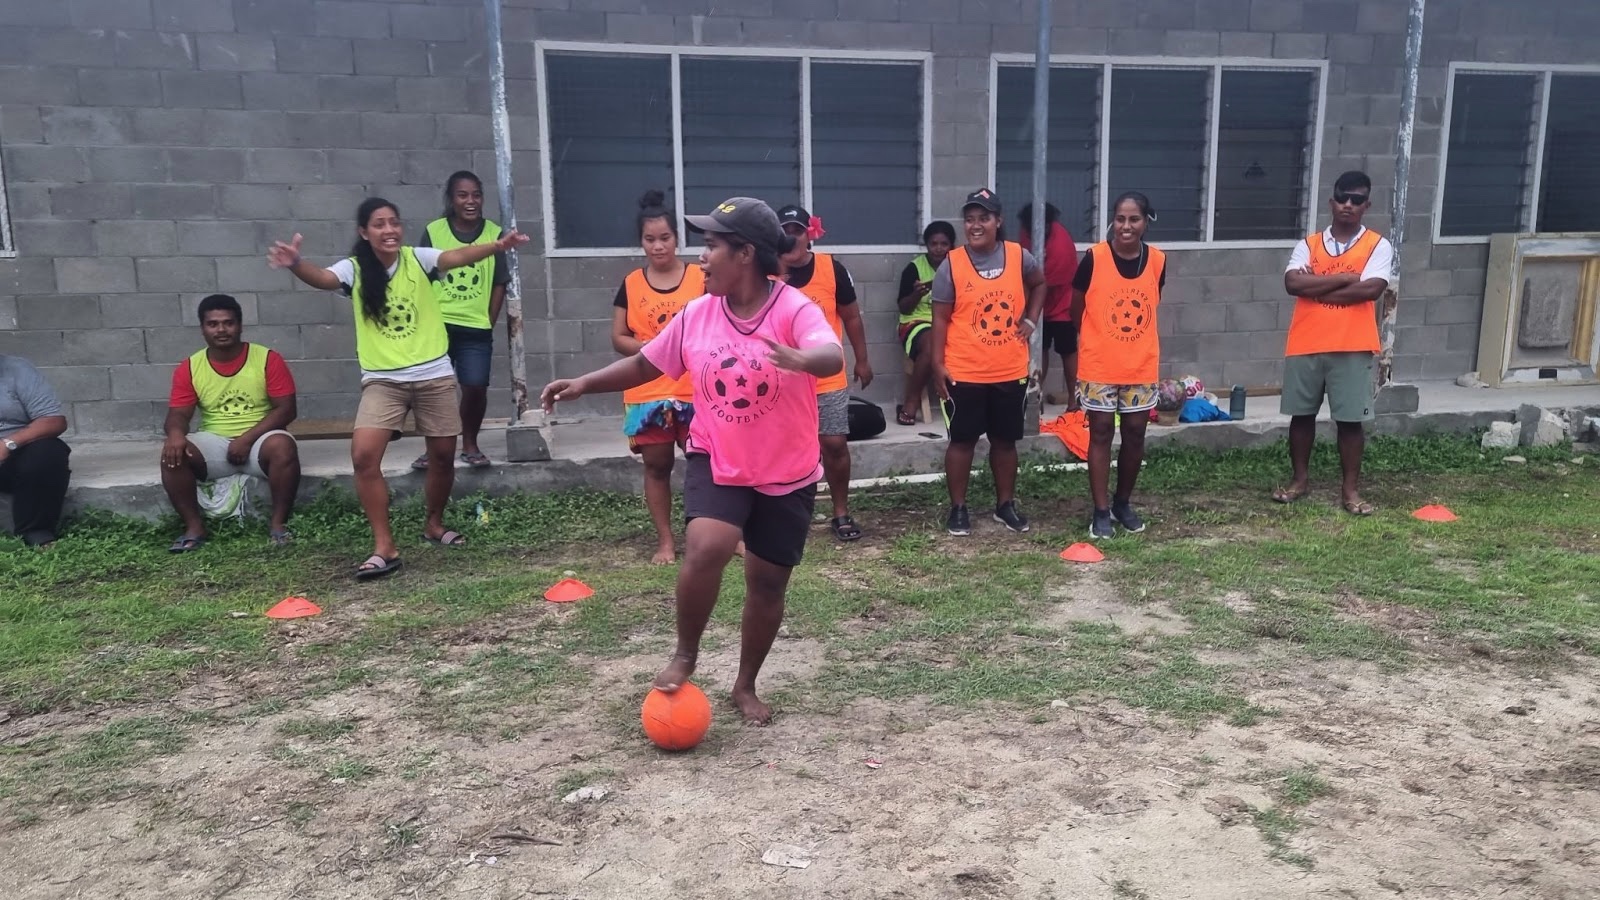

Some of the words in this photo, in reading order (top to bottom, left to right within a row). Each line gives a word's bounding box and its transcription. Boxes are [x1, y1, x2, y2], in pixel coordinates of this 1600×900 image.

[444, 287, 482, 300] FOOTBALL
[976, 290, 1005, 307] SPIRIT
[648, 301, 676, 319] SPIRIT
[710, 403, 774, 425] FOOTBALL
